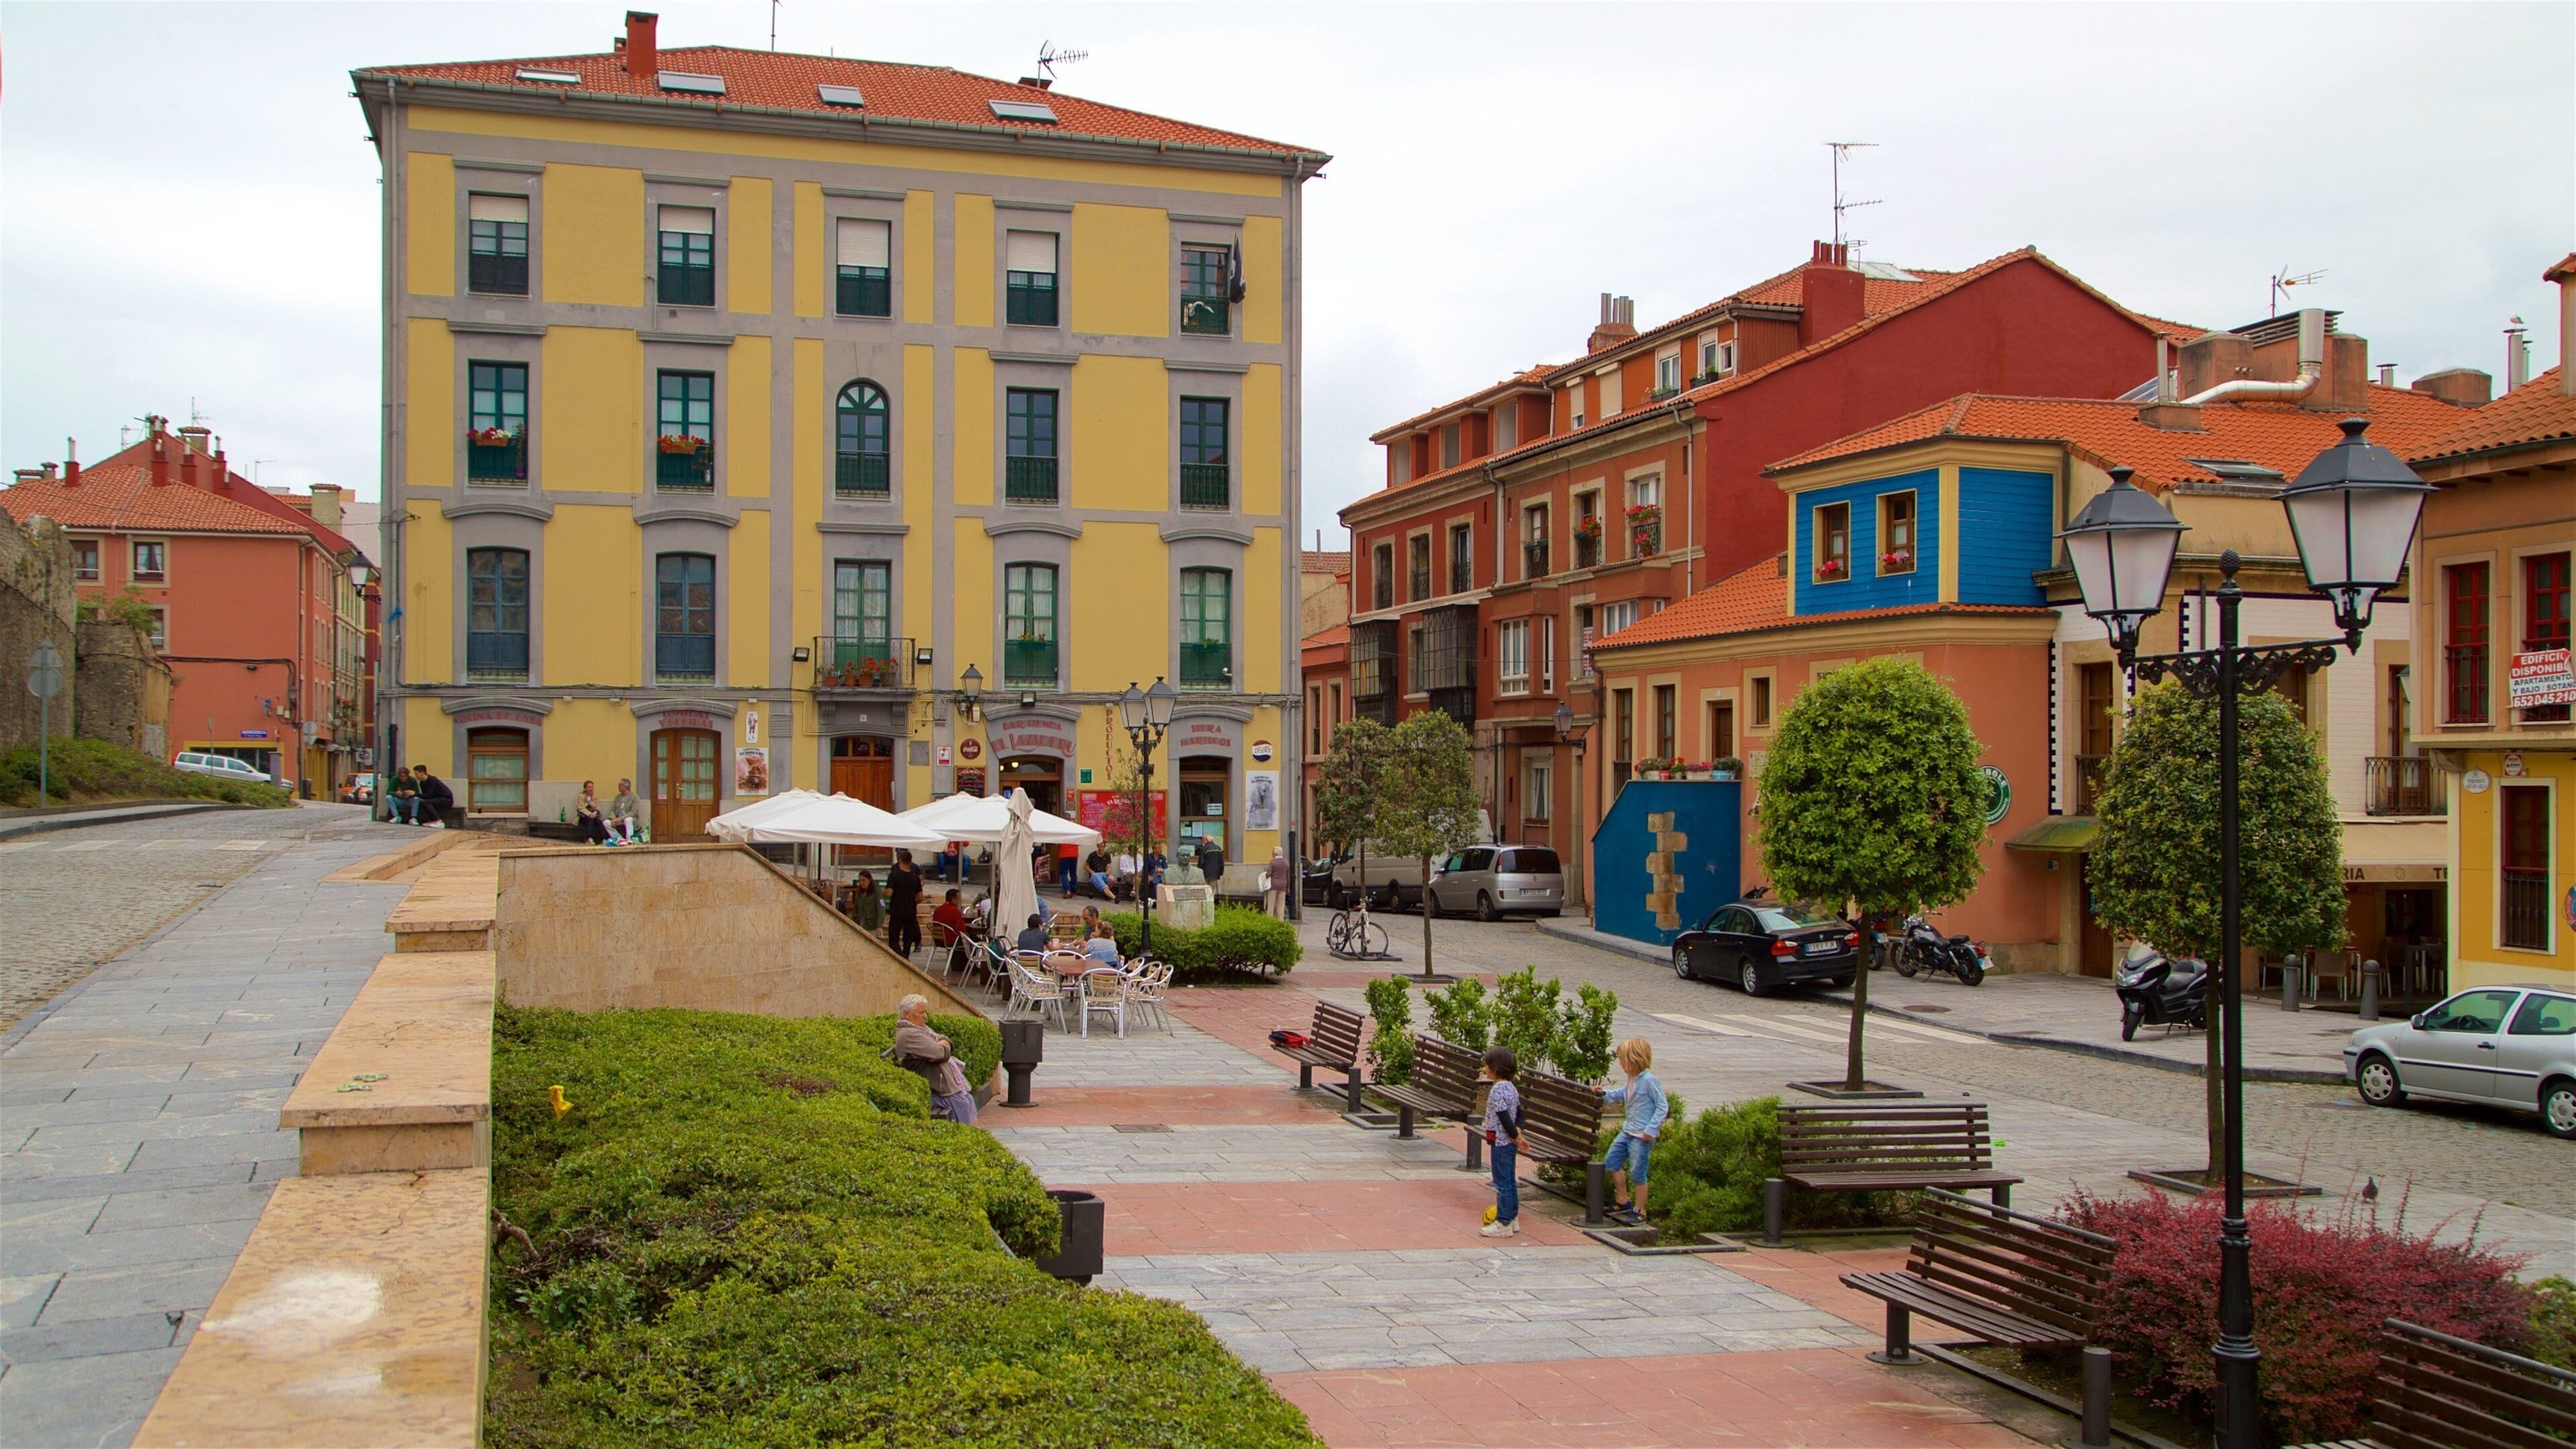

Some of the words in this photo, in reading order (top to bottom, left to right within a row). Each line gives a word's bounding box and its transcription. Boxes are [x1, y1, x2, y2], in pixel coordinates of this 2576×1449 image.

[2512, 663, 2563, 677] DISPONIB
[2514, 674, 2573, 686] APARTAMENTO
[2521, 686, 2540, 694] BAJO
[1002, 720, 1025, 731] BAR
[1027, 719, 1062, 731] TIENDA
[1191, 724, 1222, 733] SIDRA
[991, 738, 1009, 753] EL
[1180, 737, 1231, 747] MARISCOS
[2343, 868, 2365, 880] RIA
